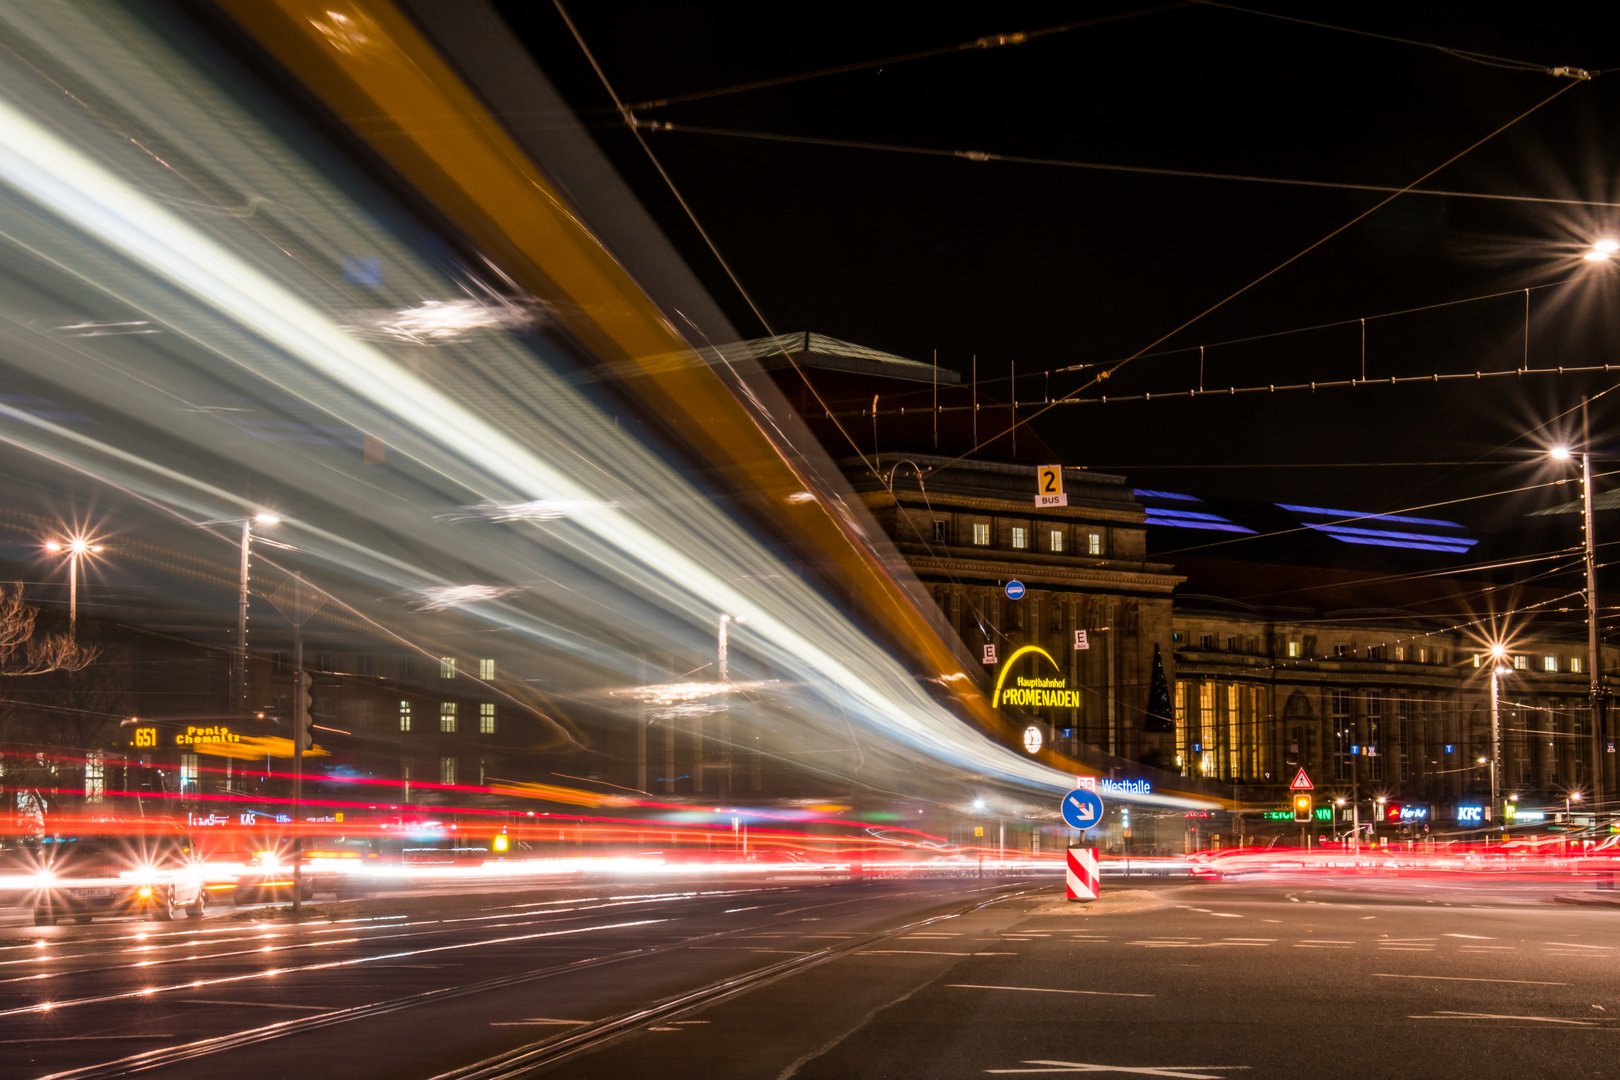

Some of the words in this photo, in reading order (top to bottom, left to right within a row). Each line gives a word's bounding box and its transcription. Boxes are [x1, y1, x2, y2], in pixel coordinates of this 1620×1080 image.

[1043, 470, 1057, 493] 2
[1077, 632, 1086, 643] E
[986, 646, 994, 657] E
[1017, 676, 1066, 689] Hauptbahnhof
[1002, 688, 1080, 708] PROMENADEN
[135, 727, 157, 747] 651
[175, 733, 241, 745] Chemnitz
[1101, 779, 1151, 794] Westhalle
[1458, 806, 1482, 820] KFC
